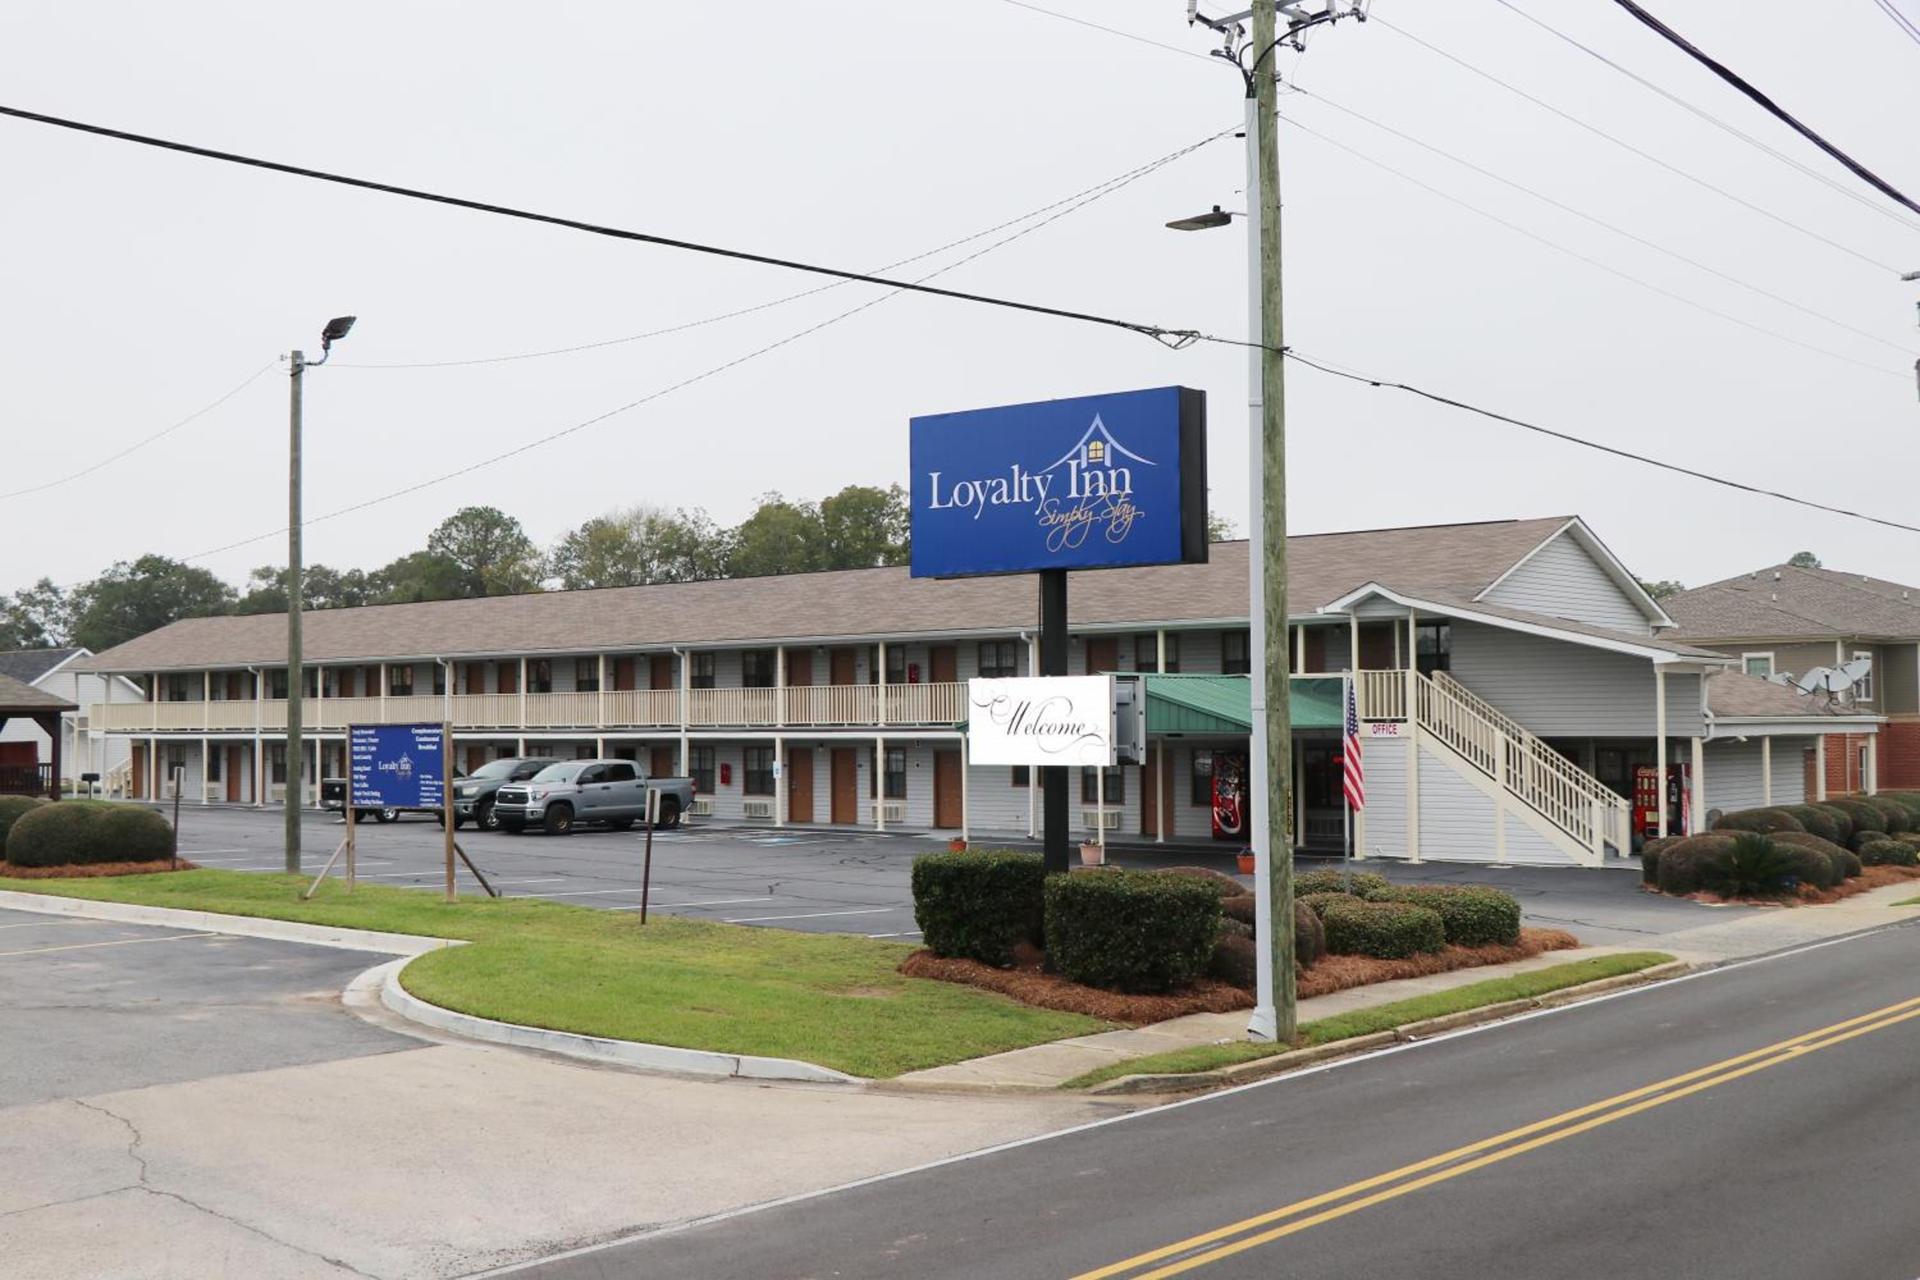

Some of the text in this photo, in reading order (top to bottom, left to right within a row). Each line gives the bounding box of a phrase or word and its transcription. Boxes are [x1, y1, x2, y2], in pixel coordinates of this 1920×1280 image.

[928, 459, 1134, 520] Loyalty Inn
[1039, 483, 1145, 552] Simply Stay
[970, 694, 1106, 754] Welcome
[1372, 723, 1397, 735] OFFICE
[378, 760, 398, 773] Loyalty
